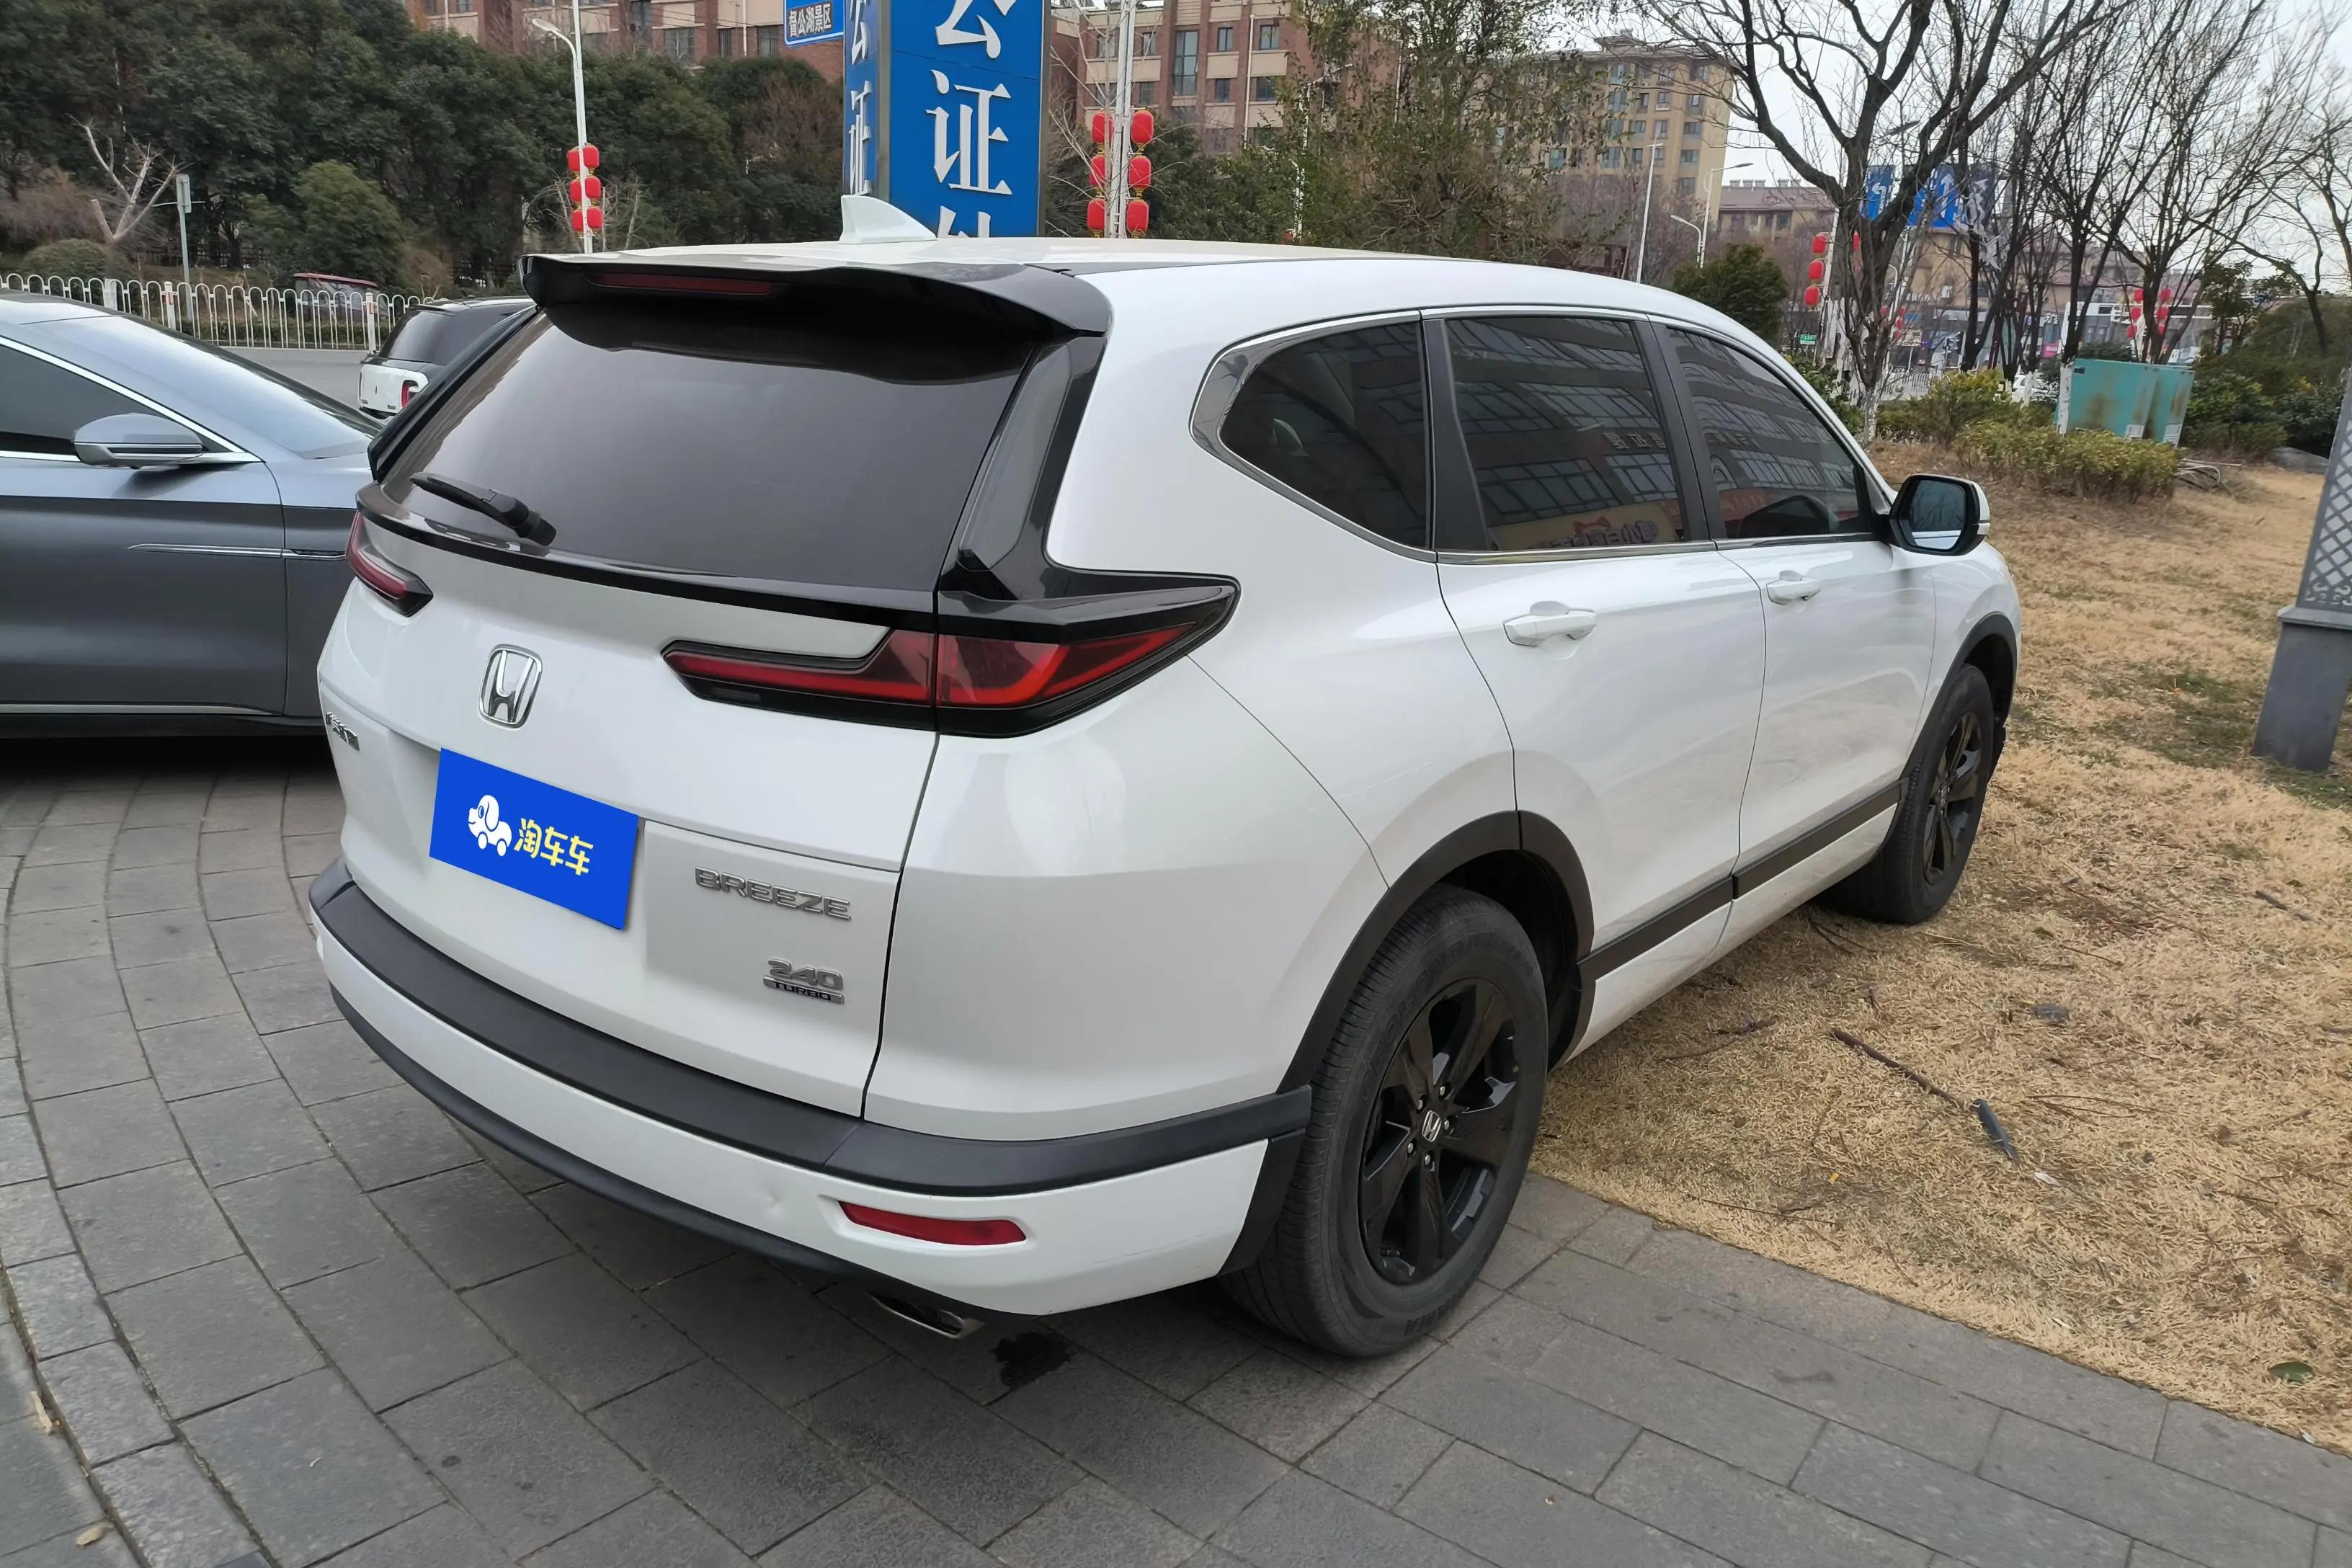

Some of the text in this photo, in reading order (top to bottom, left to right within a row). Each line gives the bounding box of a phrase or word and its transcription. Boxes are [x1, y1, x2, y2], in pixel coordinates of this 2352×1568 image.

[926, 0, 1017, 238] 公证
[695, 866, 852, 922] BREEZE
[768, 958, 843, 990] 240
[775, 981, 832, 1000] TURBO
